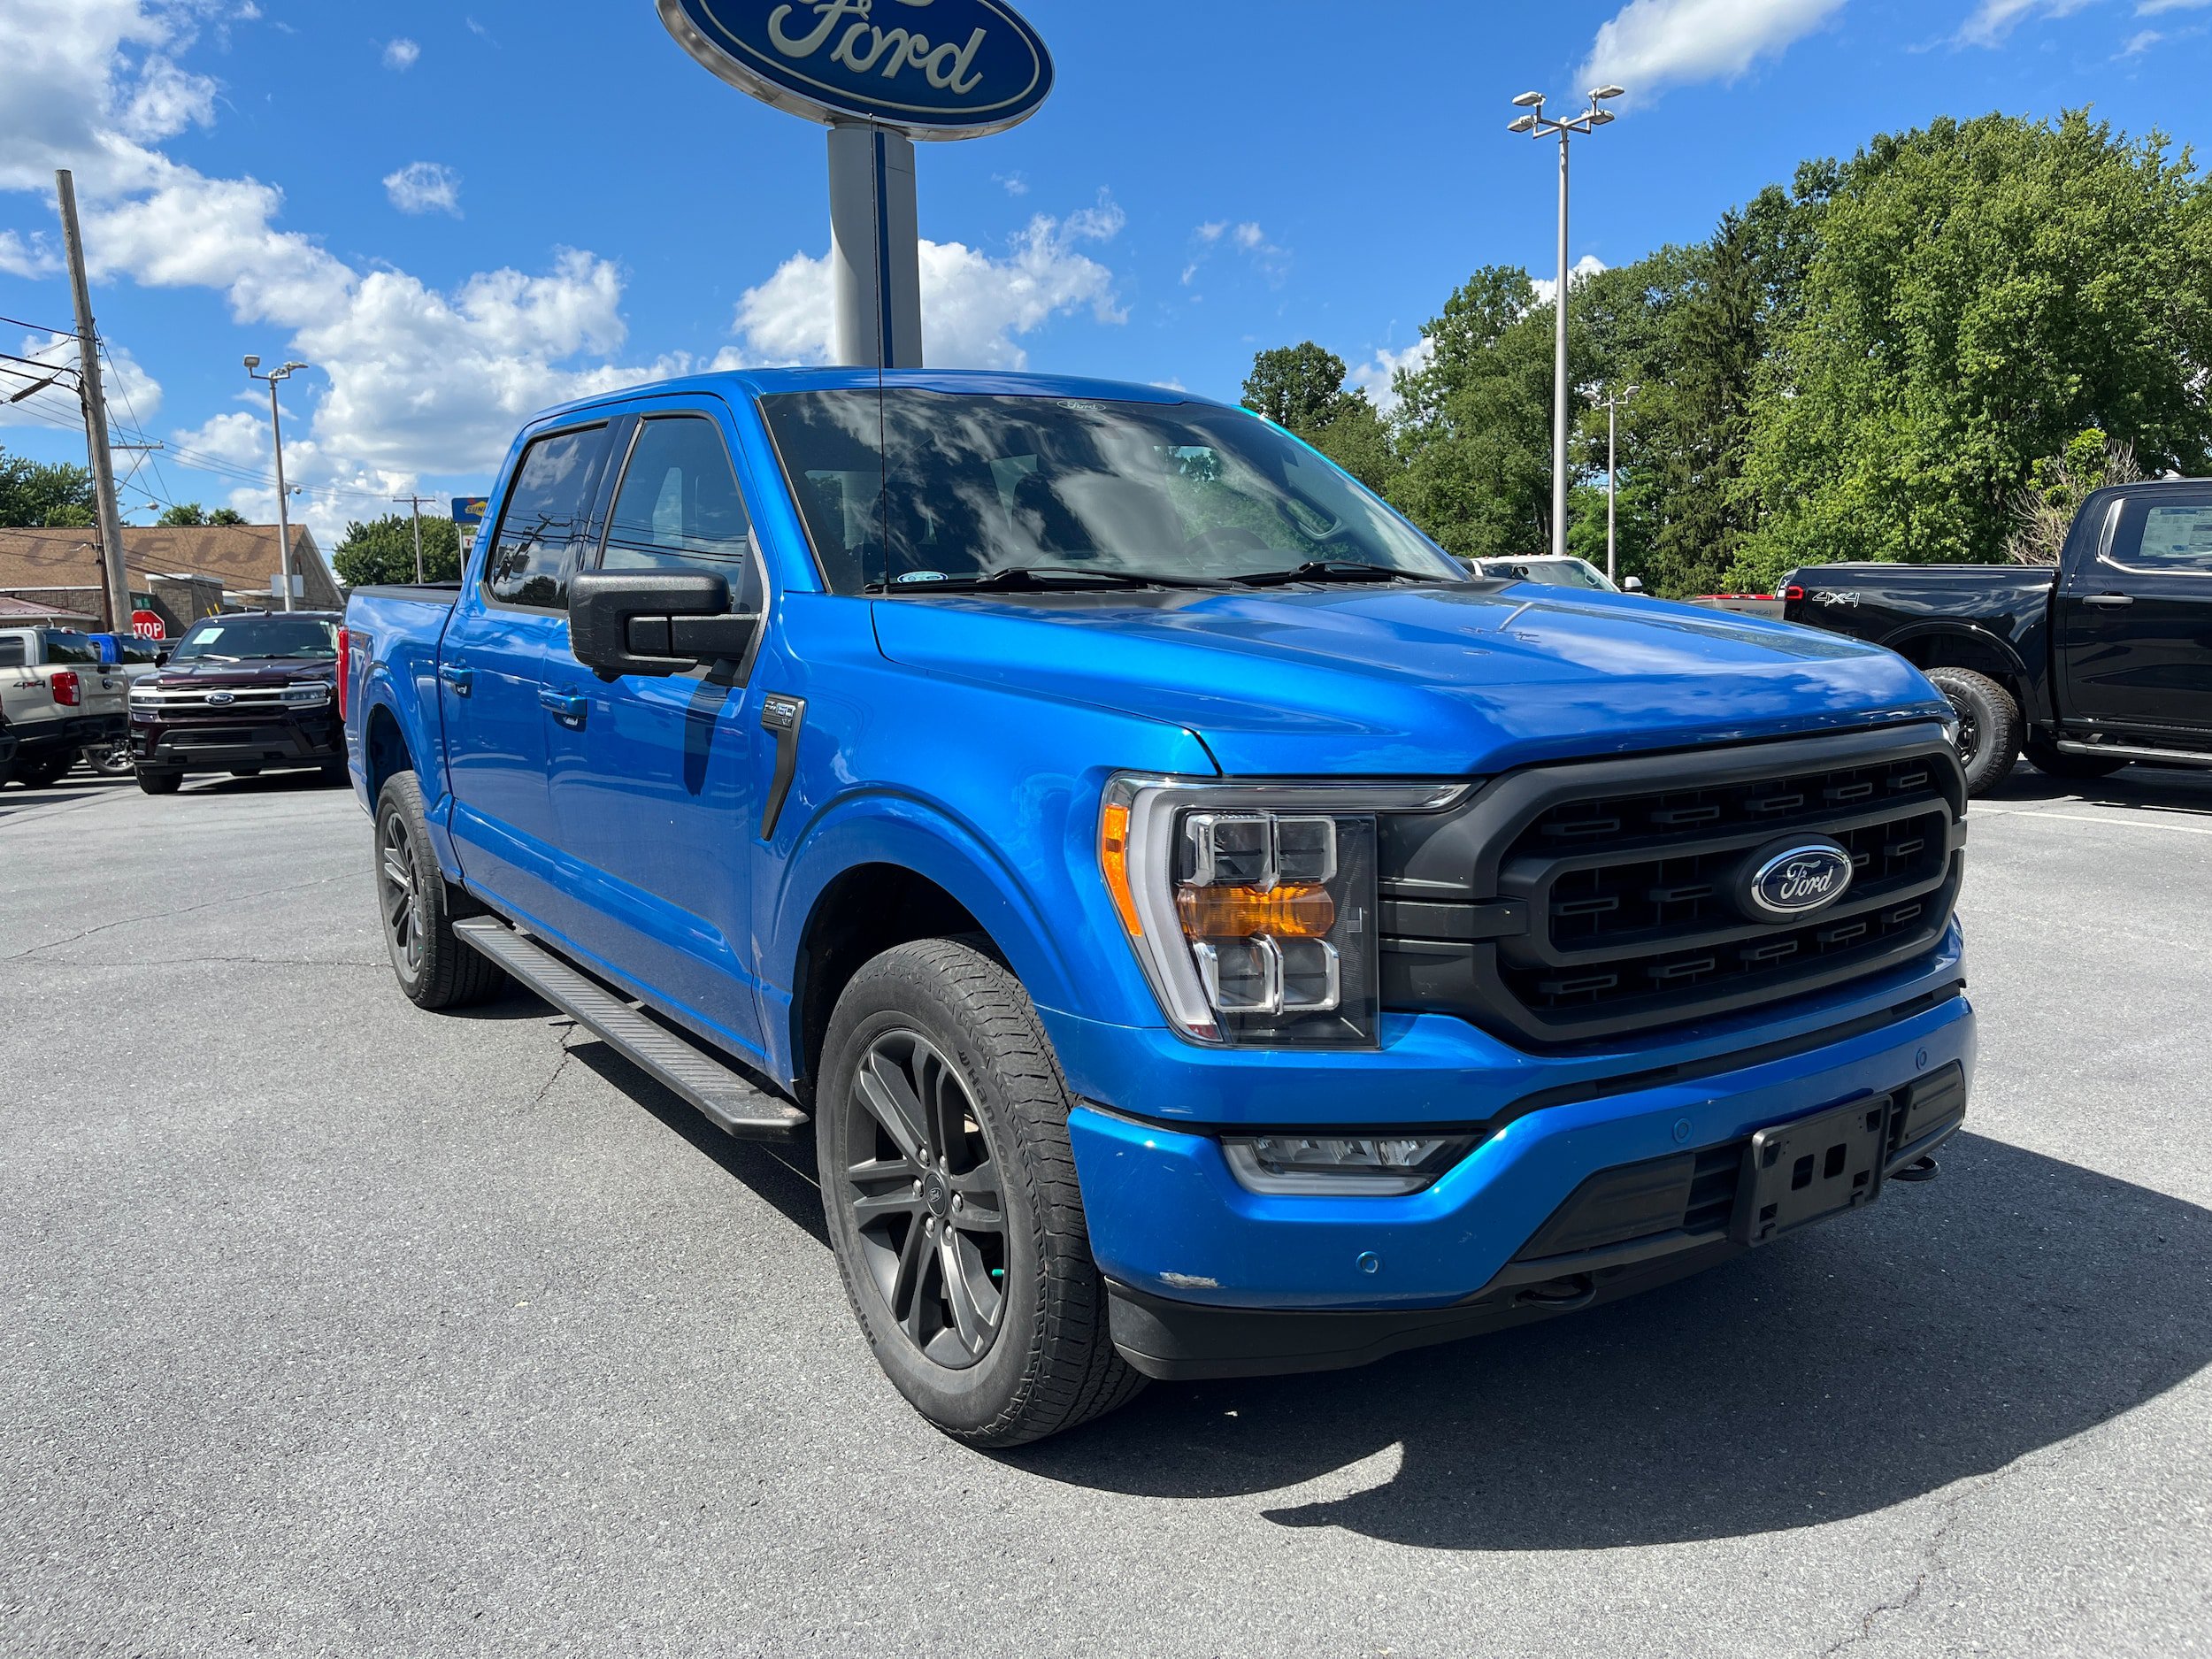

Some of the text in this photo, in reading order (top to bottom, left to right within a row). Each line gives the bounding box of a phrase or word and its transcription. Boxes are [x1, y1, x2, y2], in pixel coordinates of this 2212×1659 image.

[767, 0, 987, 95] Ford
[1066, 400, 1098, 410] Ford
[1780, 860, 1833, 900] Ford
